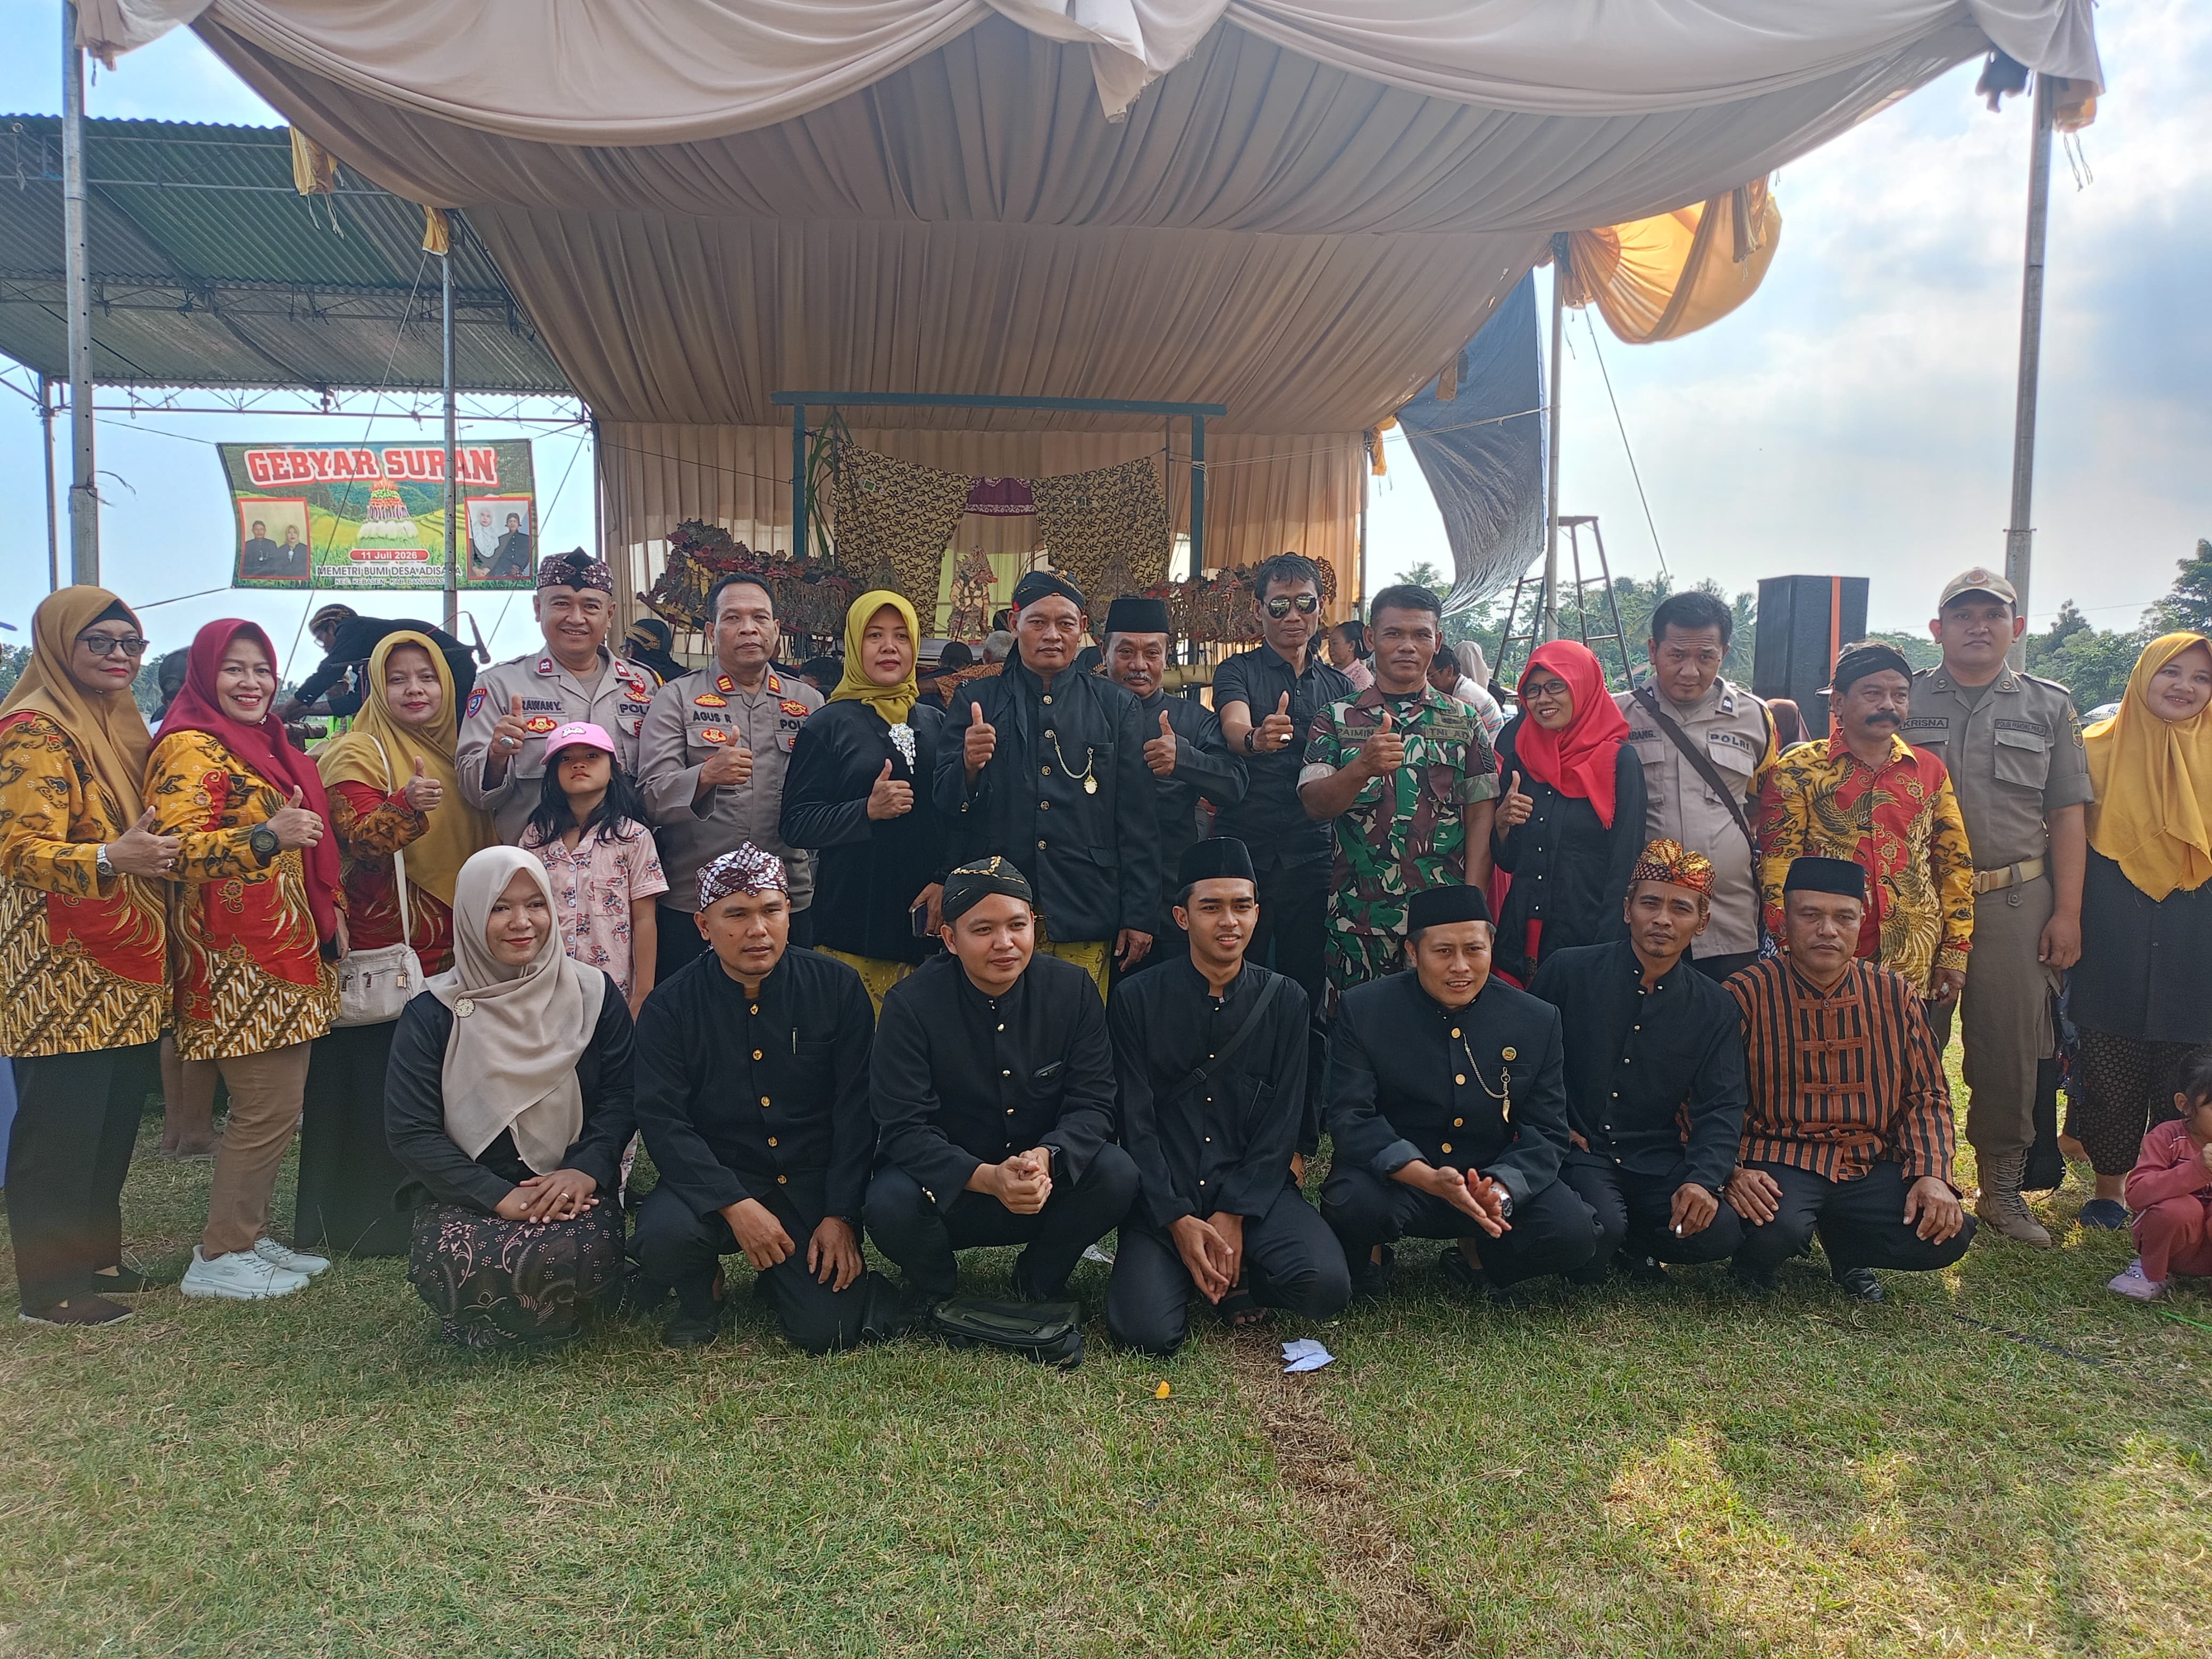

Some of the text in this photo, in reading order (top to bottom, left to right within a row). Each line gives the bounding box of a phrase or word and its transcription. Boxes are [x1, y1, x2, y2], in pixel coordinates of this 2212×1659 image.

[247, 449, 495, 483] GEBYAR SURAN
[317, 566, 462, 575] MEMETRI BUMI DESA ADISAA
[619, 703, 649, 715] POL
[693, 710, 732, 724] AGUS R
[780, 719, 801, 730] POL
[1903, 719, 1945, 728] KRISNA
[1629, 730, 1656, 740] BANG.
[1710, 734, 1749, 750] POLRI
